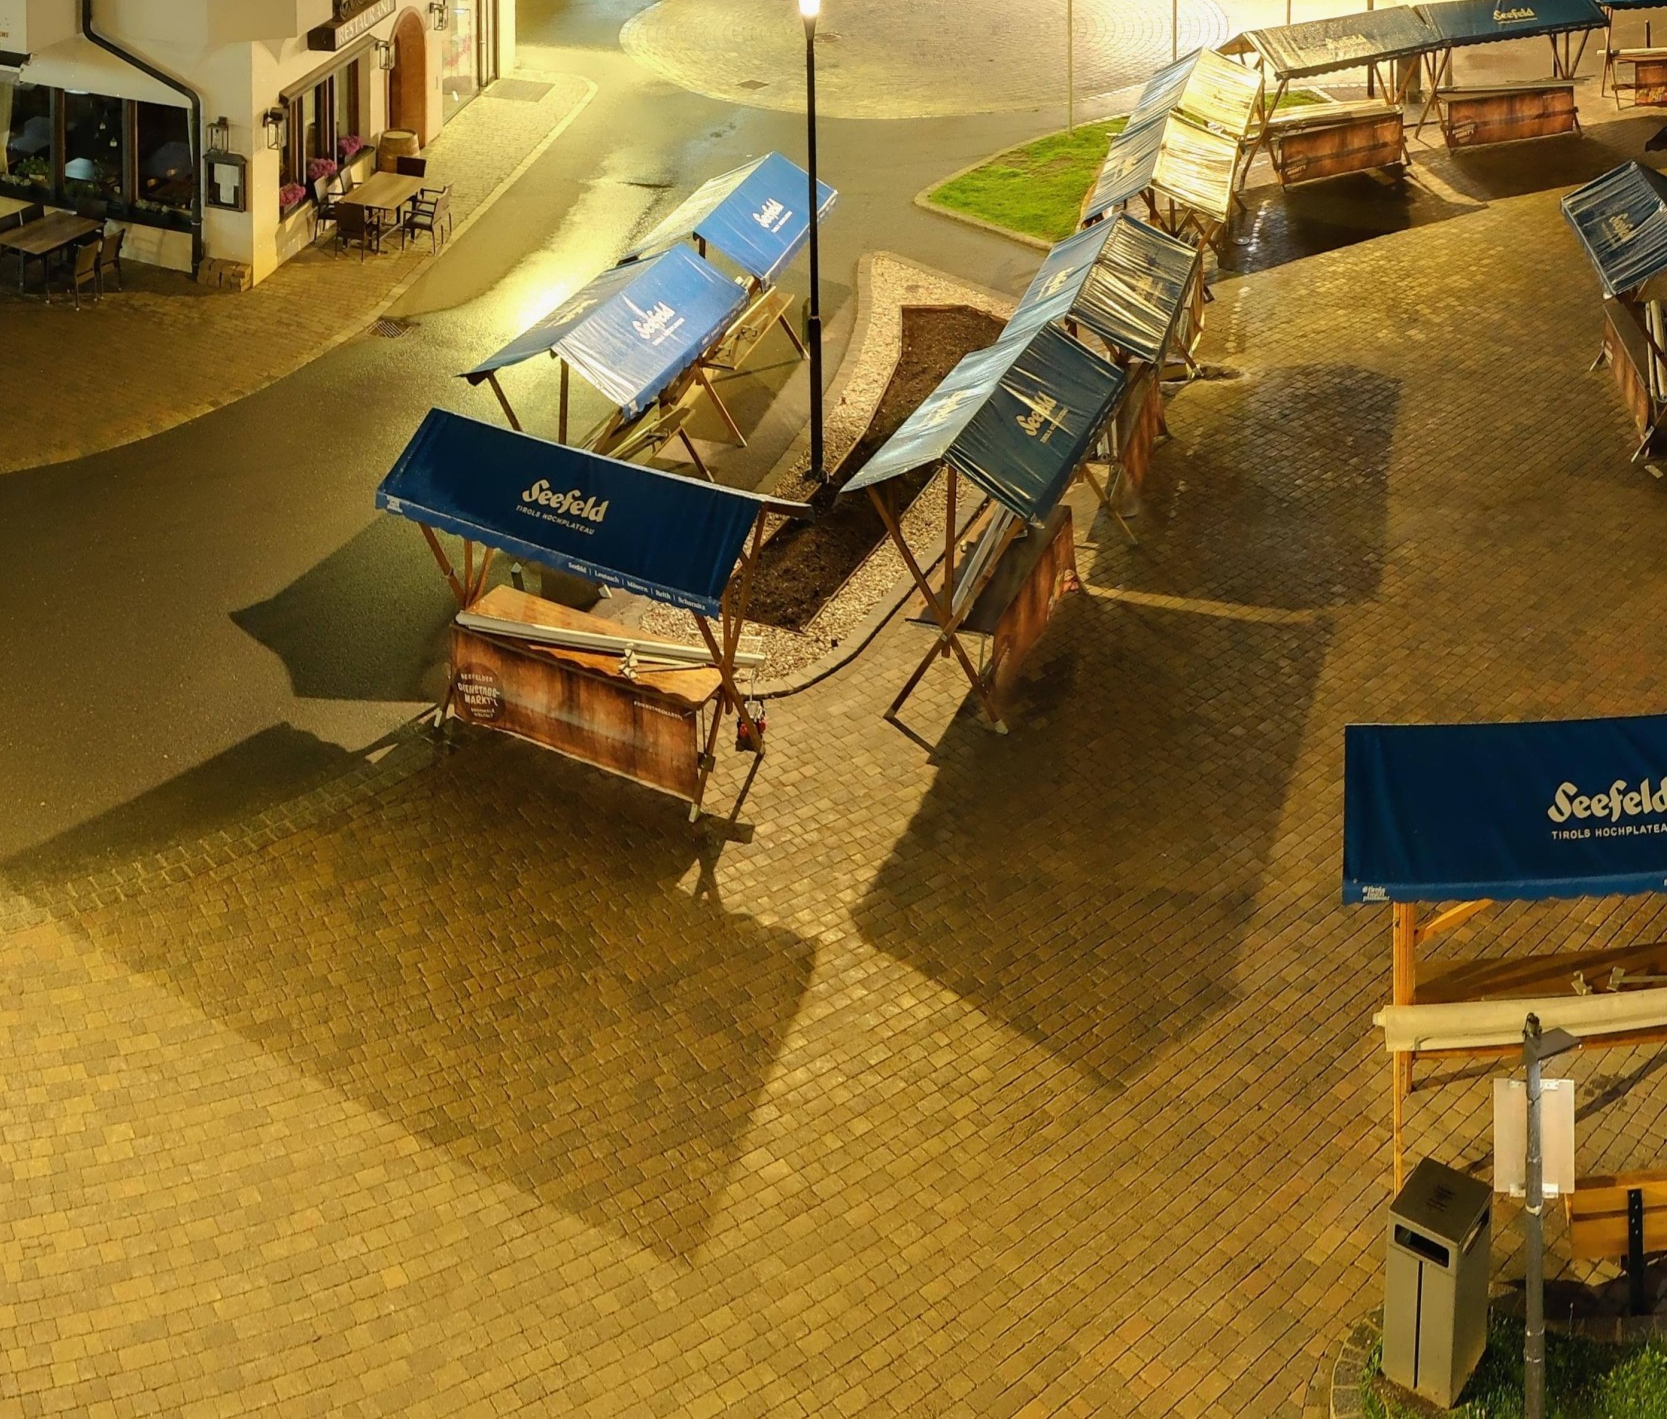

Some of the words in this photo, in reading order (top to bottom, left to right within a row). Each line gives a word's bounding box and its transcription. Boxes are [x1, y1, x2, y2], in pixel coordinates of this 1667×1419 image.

[522, 479, 609, 523] Seefeld
[516, 505, 541, 518] TIROLS
[542, 512, 595, 536] HOCHPLATEAU
[1551, 827, 1592, 841] TIROLS
